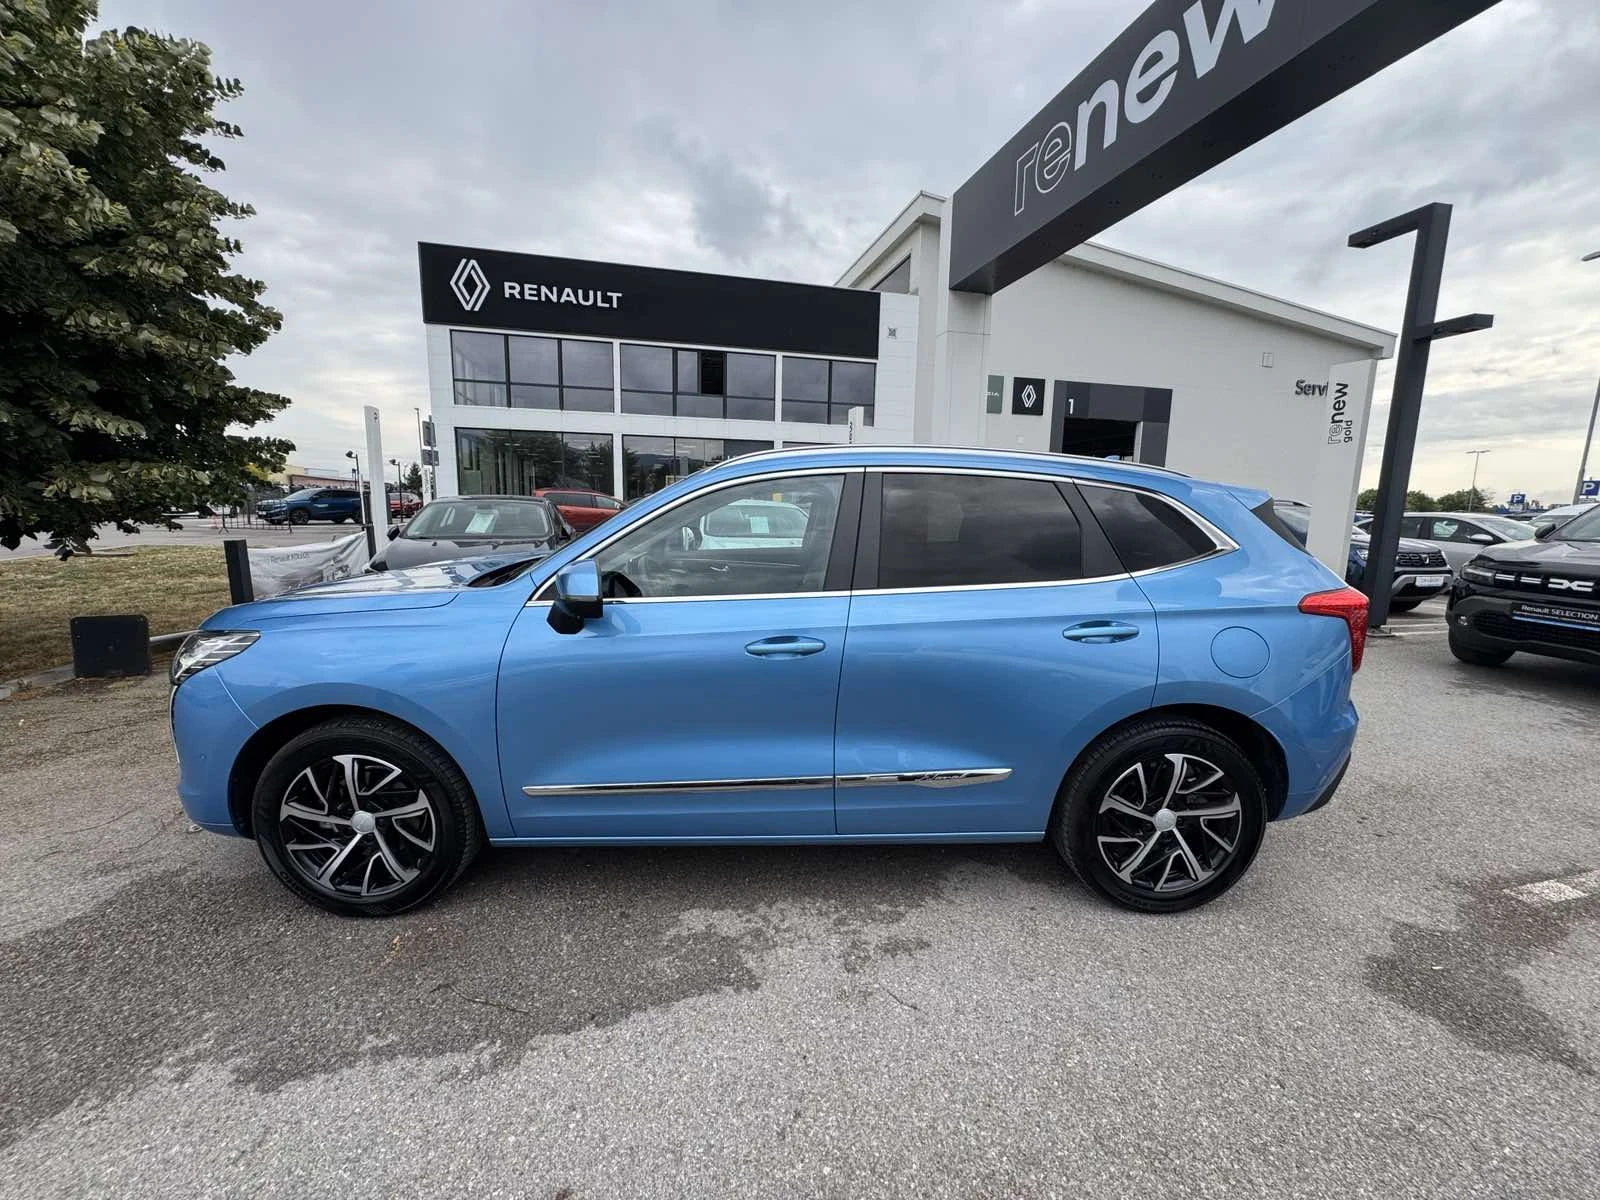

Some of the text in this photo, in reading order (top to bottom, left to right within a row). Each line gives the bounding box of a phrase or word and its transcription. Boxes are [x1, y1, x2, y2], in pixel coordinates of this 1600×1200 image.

[1014, 0, 1276, 216] renew
[503, 281, 623, 309] RENAULT
[1068, 398, 1074, 415] 1
[1328, 383, 1349, 444] renew
[1343, 420, 1353, 443] gold
[1582, 482, 1596, 495] P
[1513, 495, 1522, 503] P
[1521, 604, 1550, 614] Renault
[1551, 608, 1599, 620] SELECTION
